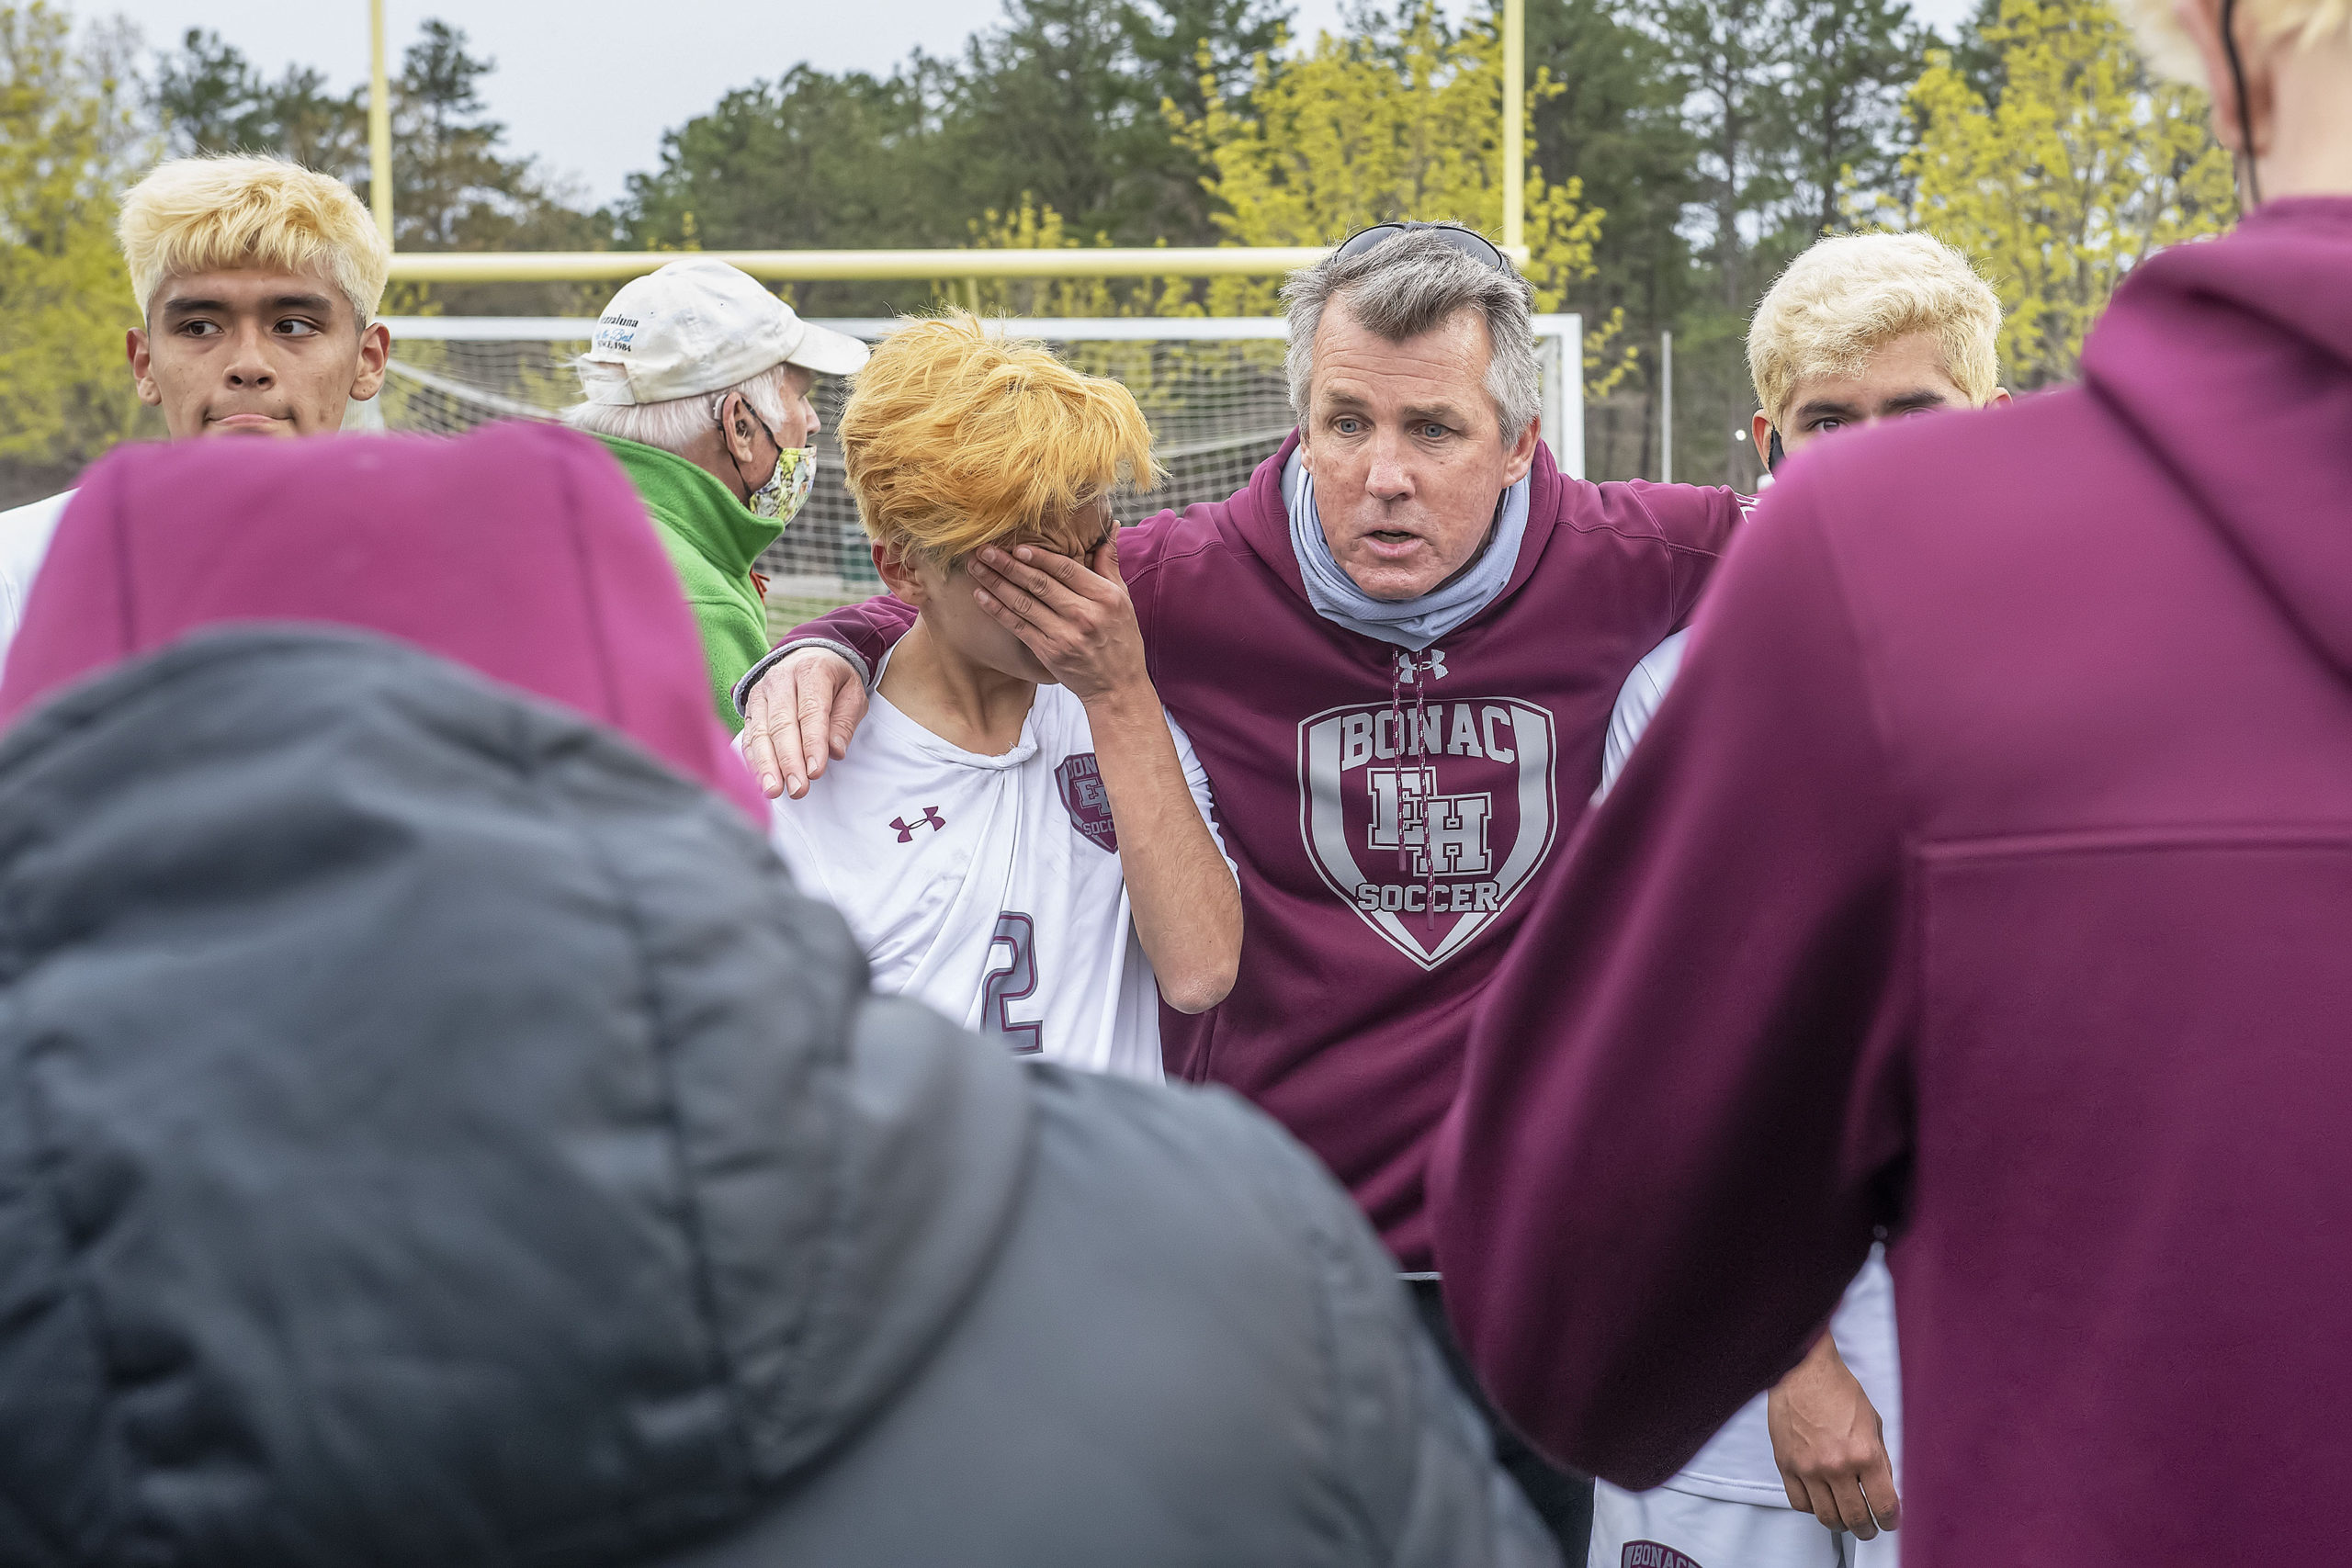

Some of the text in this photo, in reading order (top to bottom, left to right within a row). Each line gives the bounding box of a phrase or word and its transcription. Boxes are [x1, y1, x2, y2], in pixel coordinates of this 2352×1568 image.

[615, 342, 631, 352] 1984
[1341, 704, 1515, 772] BONAC
[1367, 766, 1493, 877] EH
[1357, 881, 1499, 913] SOCCER
[979, 910, 1044, 1056] 2
